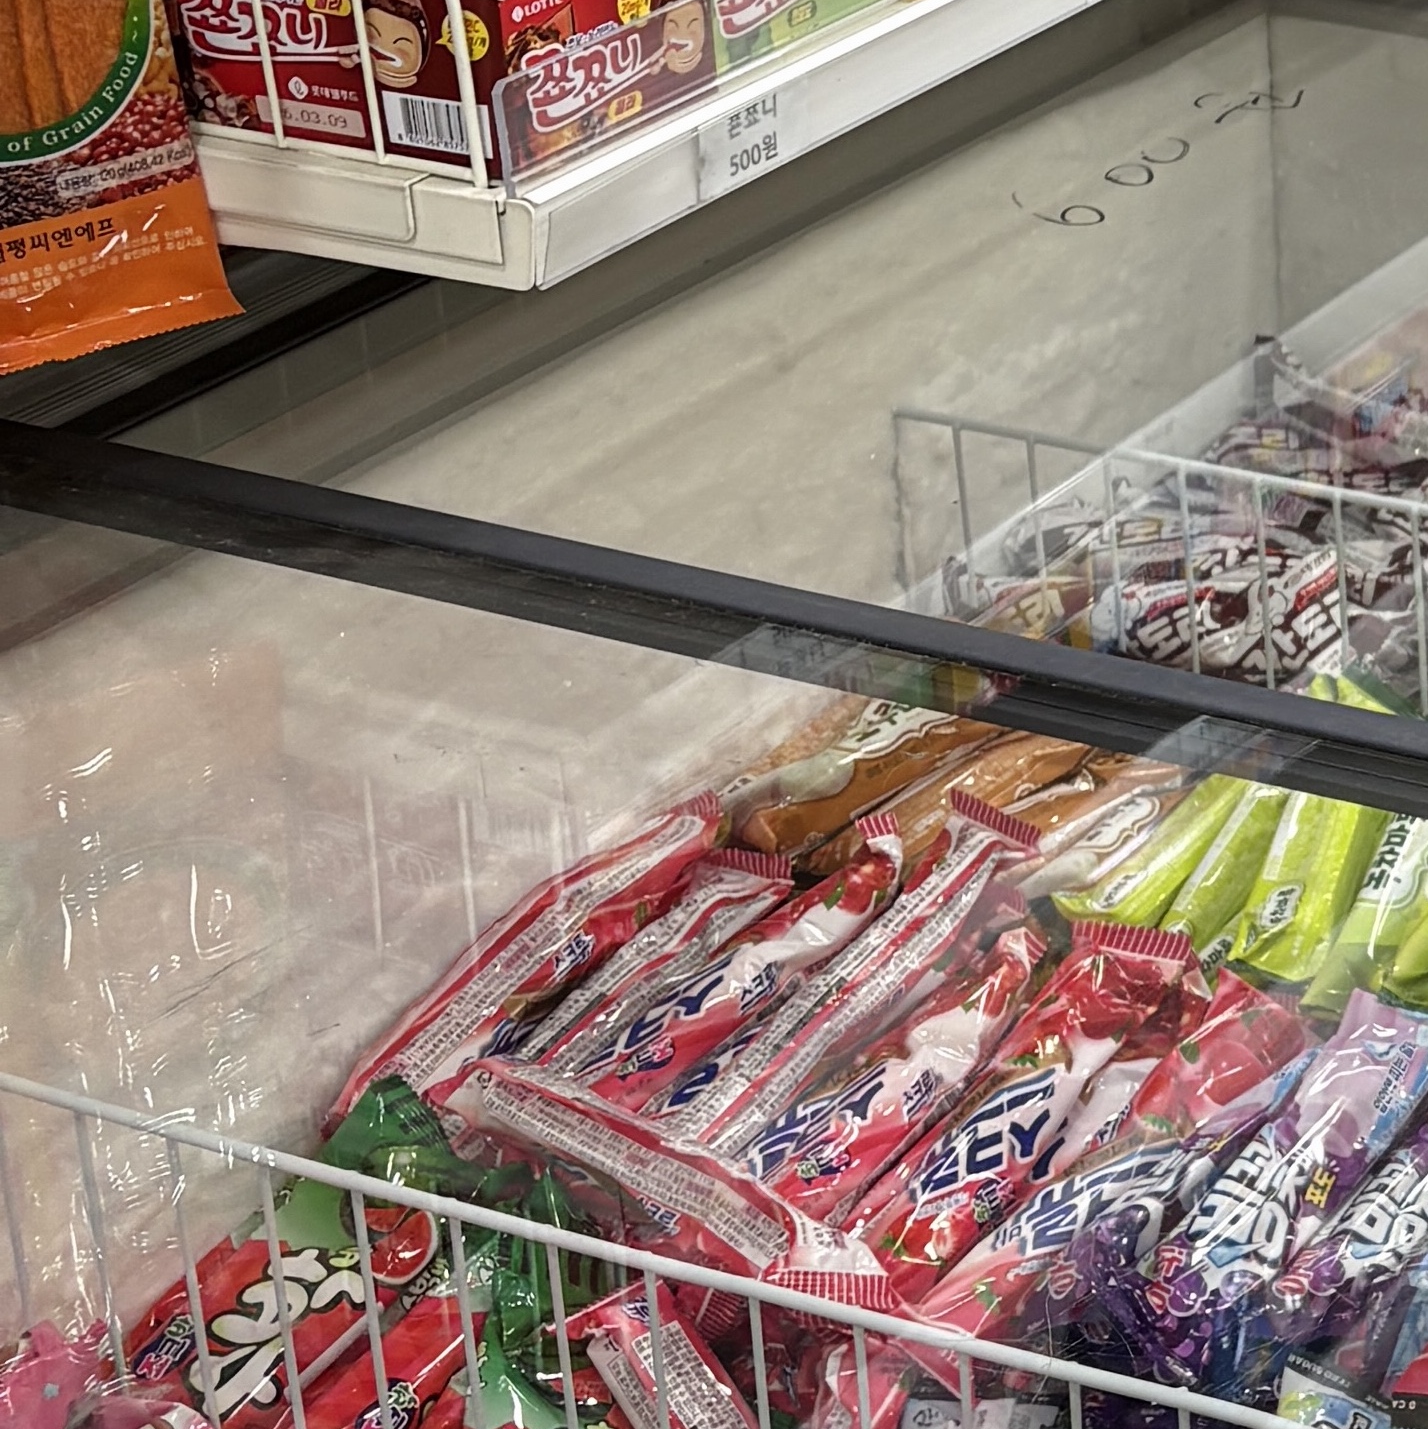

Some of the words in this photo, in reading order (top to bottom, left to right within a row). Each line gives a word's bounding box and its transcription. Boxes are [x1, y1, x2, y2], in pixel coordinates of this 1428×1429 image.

[7, 137, 33, 153] of
[42, 104, 104, 146] Grain
[102, 52, 138, 103] Food
[281, 109, 347, 130] 6.03.09
[729, 134, 779, 177] 500원
